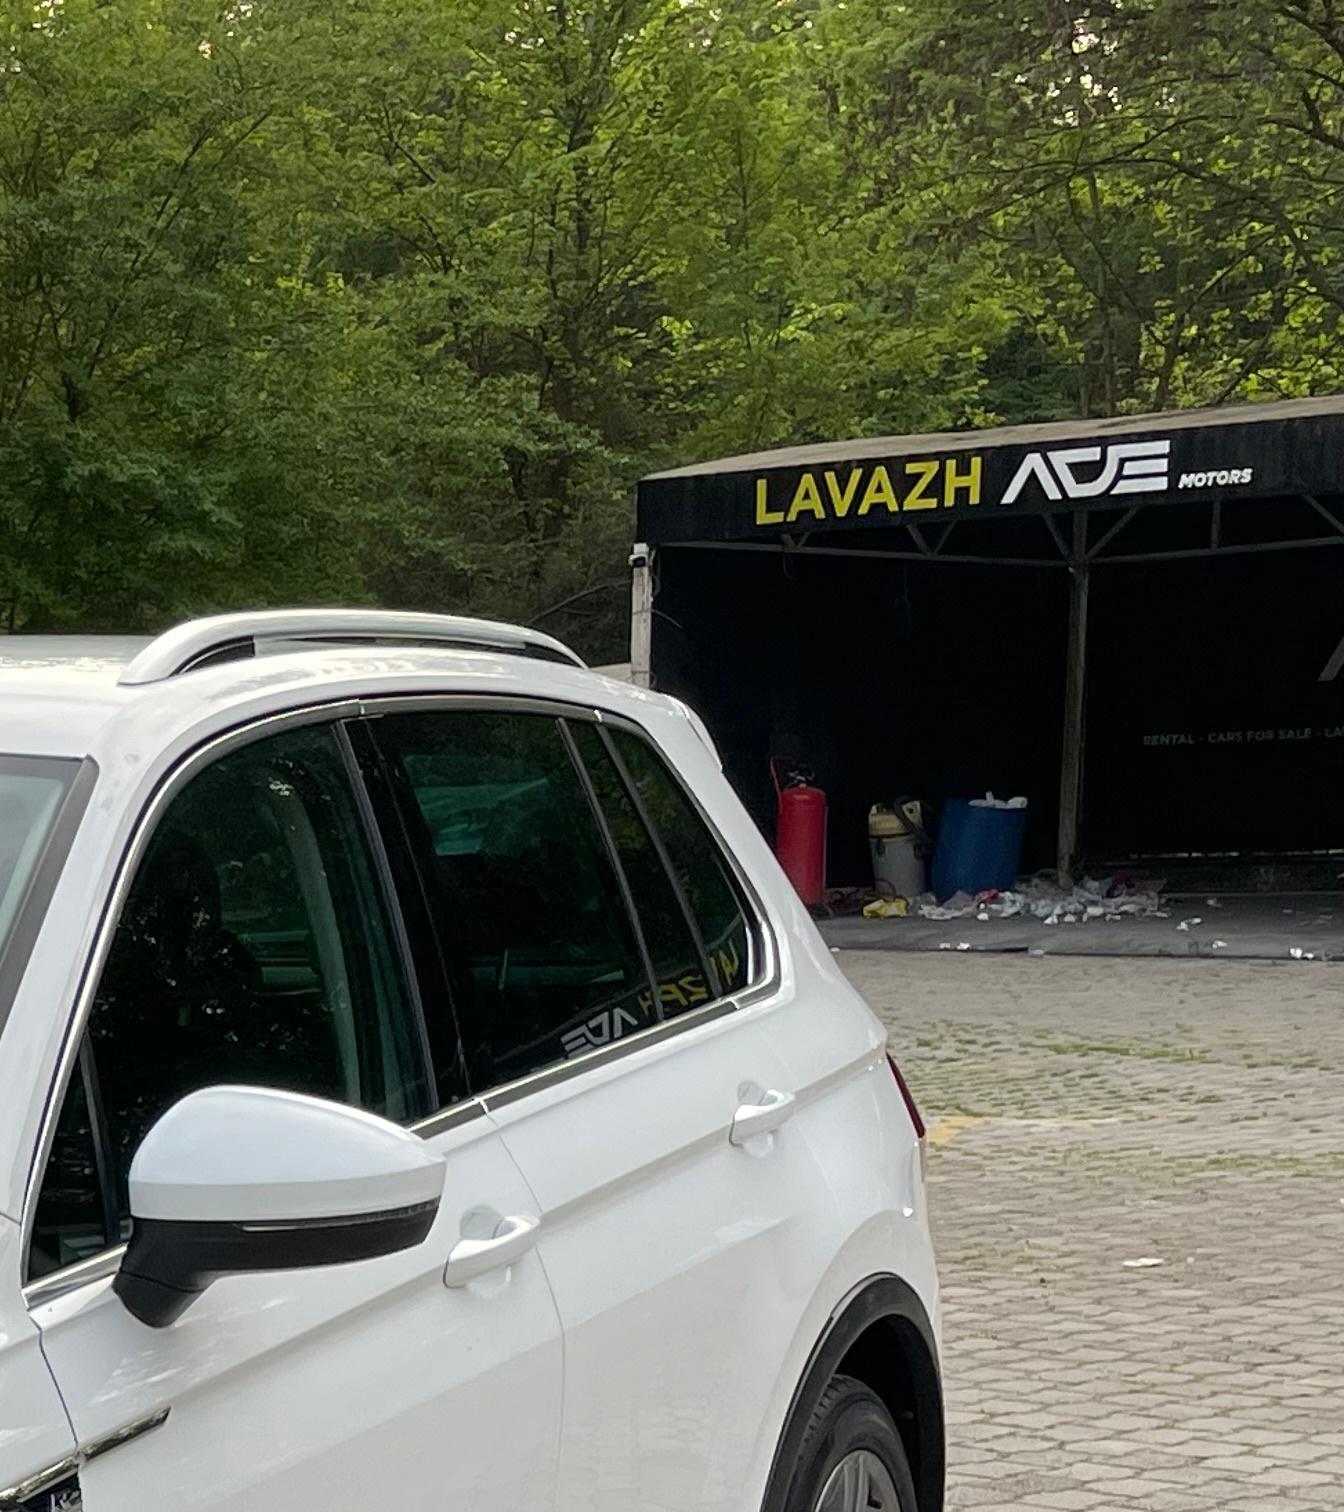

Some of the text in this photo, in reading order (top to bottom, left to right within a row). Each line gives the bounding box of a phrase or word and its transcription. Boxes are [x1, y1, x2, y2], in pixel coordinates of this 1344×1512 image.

[755, 455, 982, 525] LAVAZH
[1178, 467, 1252, 489] MOTORS
[1143, 734, 1195, 746] RENTAL
[1207, 731, 1243, 744] CARS
[1247, 730, 1274, 742] FOR
[1278, 727, 1313, 740] SALE
